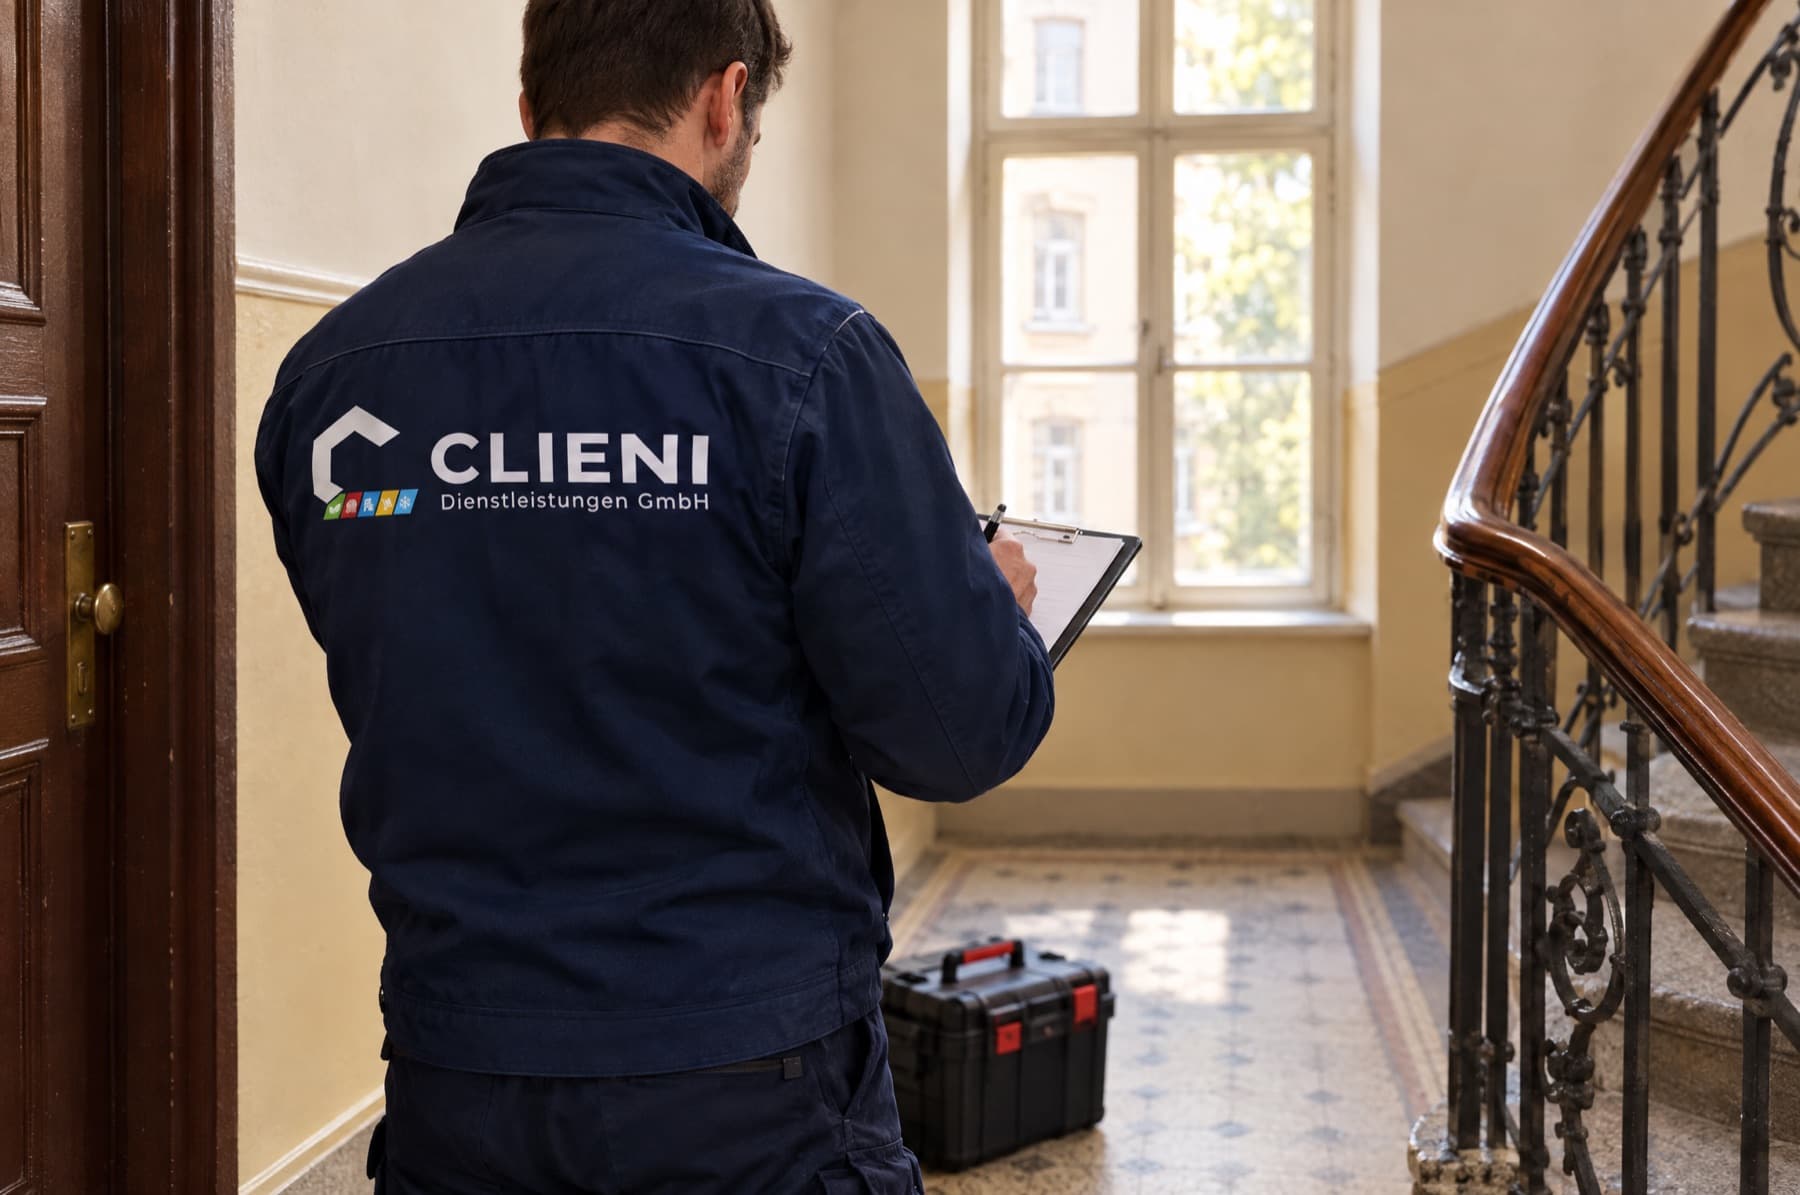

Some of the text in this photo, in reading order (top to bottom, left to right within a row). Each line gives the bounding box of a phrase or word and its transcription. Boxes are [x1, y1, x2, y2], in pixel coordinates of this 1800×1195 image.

[430, 432, 710, 485] CLIENI
[441, 490, 709, 513] Dienstleistungen GmbH
